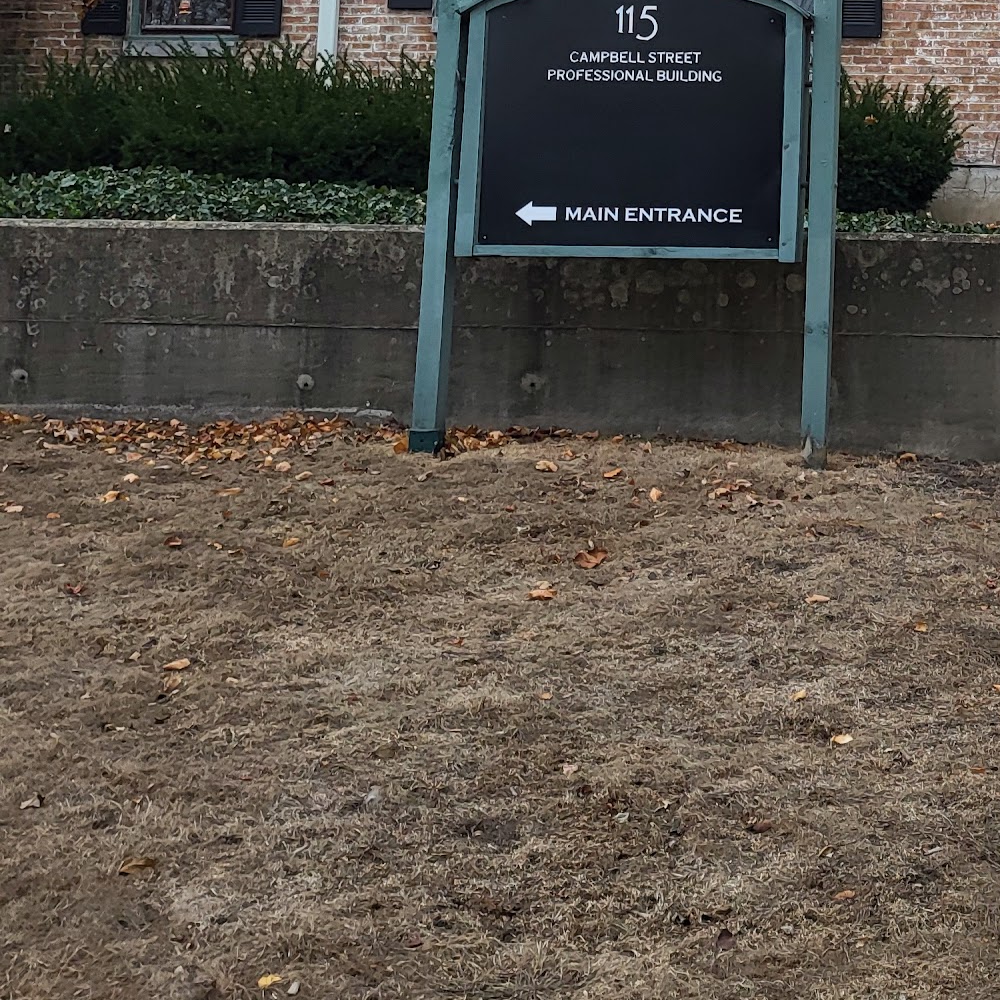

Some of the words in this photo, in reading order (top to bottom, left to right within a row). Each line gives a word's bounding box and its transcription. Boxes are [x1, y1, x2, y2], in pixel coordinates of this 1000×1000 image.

[615, 4, 659, 41] 115
[569, 50, 645, 64] CAMPBELL
[647, 51, 702, 65] STREET
[547, 68, 653, 83] PROFESSIONAL
[656, 69, 723, 83] BUILDING
[564, 206, 620, 223] MAIN
[624, 207, 743, 224] ENTRANCE
